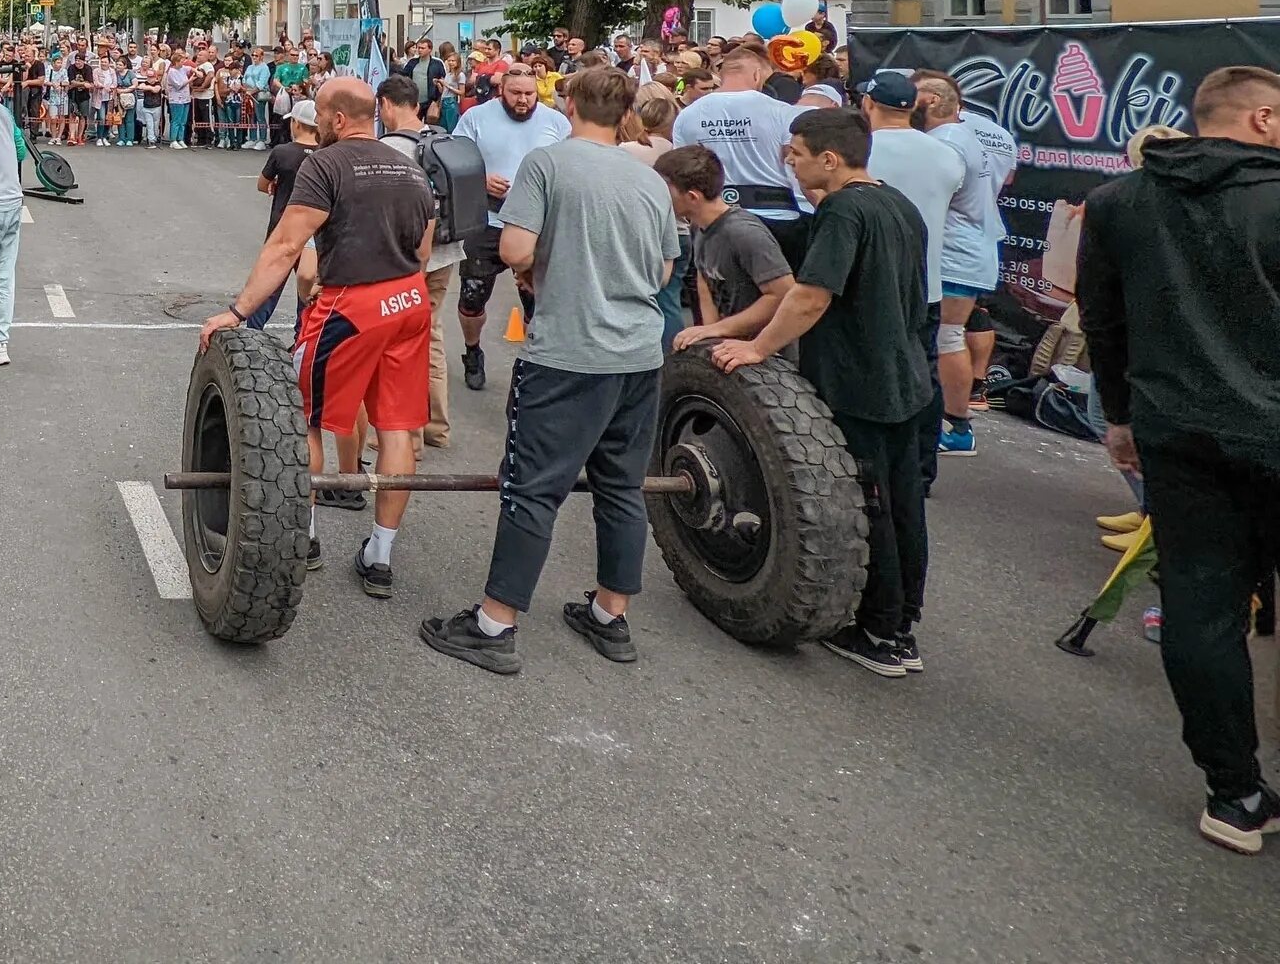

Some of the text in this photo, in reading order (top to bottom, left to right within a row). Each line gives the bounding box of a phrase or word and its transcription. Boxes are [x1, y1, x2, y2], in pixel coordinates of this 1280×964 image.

[701, 117, 751, 128] ВАЛЕРИЙ
[709, 128, 745, 137] САВИН
[975, 129, 1004, 141] РОМАН
[1037, 150, 1067, 164] для
[1019, 198, 1036, 210] 05
[1038, 201, 1054, 213] 96
[1019, 237, 1034, 249] 79
[1036, 239, 1051, 252] 79
[1020, 275, 1035, 289] 89
[1037, 279, 1053, 293] 99
[380, 288, 422, 317] ASICS
